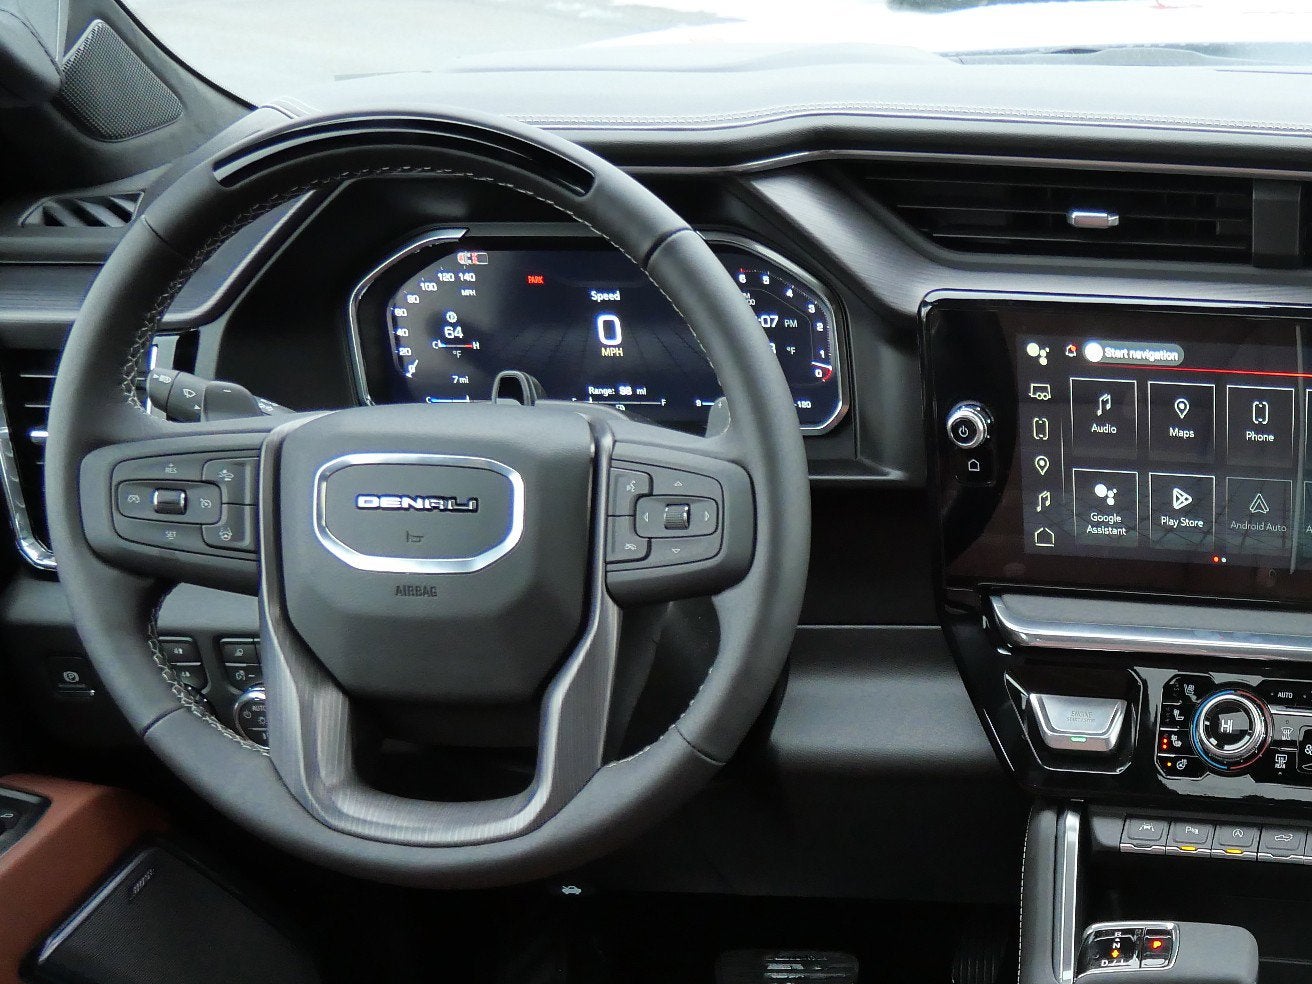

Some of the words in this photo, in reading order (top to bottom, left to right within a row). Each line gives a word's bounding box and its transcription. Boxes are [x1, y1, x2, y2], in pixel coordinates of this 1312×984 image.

[438, 272, 455, 282] 120
[458, 272, 476, 282] 140
[527, 275, 545, 285] PARK
[420, 282, 438, 291] 100
[590, 290, 621, 302] Speed
[786, 289, 794, 298] 4
[808, 304, 816, 313] 3
[757, 315, 779, 328] :07
[784, 319, 798, 328] PM
[816, 322, 824, 331] 2
[396, 328, 409, 337] 40
[444, 326, 464, 339] 64
[597, 314, 623, 346] 0
[398, 347, 412, 356] 20
[601, 347, 624, 357] MPH
[1104, 347, 1128, 359] Start
[1129, 348, 1179, 362] navigation
[588, 386, 616, 397] Range:
[636, 387, 647, 395] mi
[1091, 423, 1117, 434] Audio
[1169, 427, 1195, 440] Maps
[1246, 431, 1275, 442] Phone
[355, 493, 479, 513] DENALI
[1090, 512, 1122, 525] Google
[1161, 515, 1179, 528] Play
[1180, 517, 1204, 528] Store
[1086, 524, 1127, 536] Assistant
[1230, 520, 1265, 531] Android
[1266, 522, 1287, 532] Auto
[394, 584, 438, 597] AIRBAG
[1277, 691, 1293, 699] AUTO
[1220, 719, 1234, 734] HI
